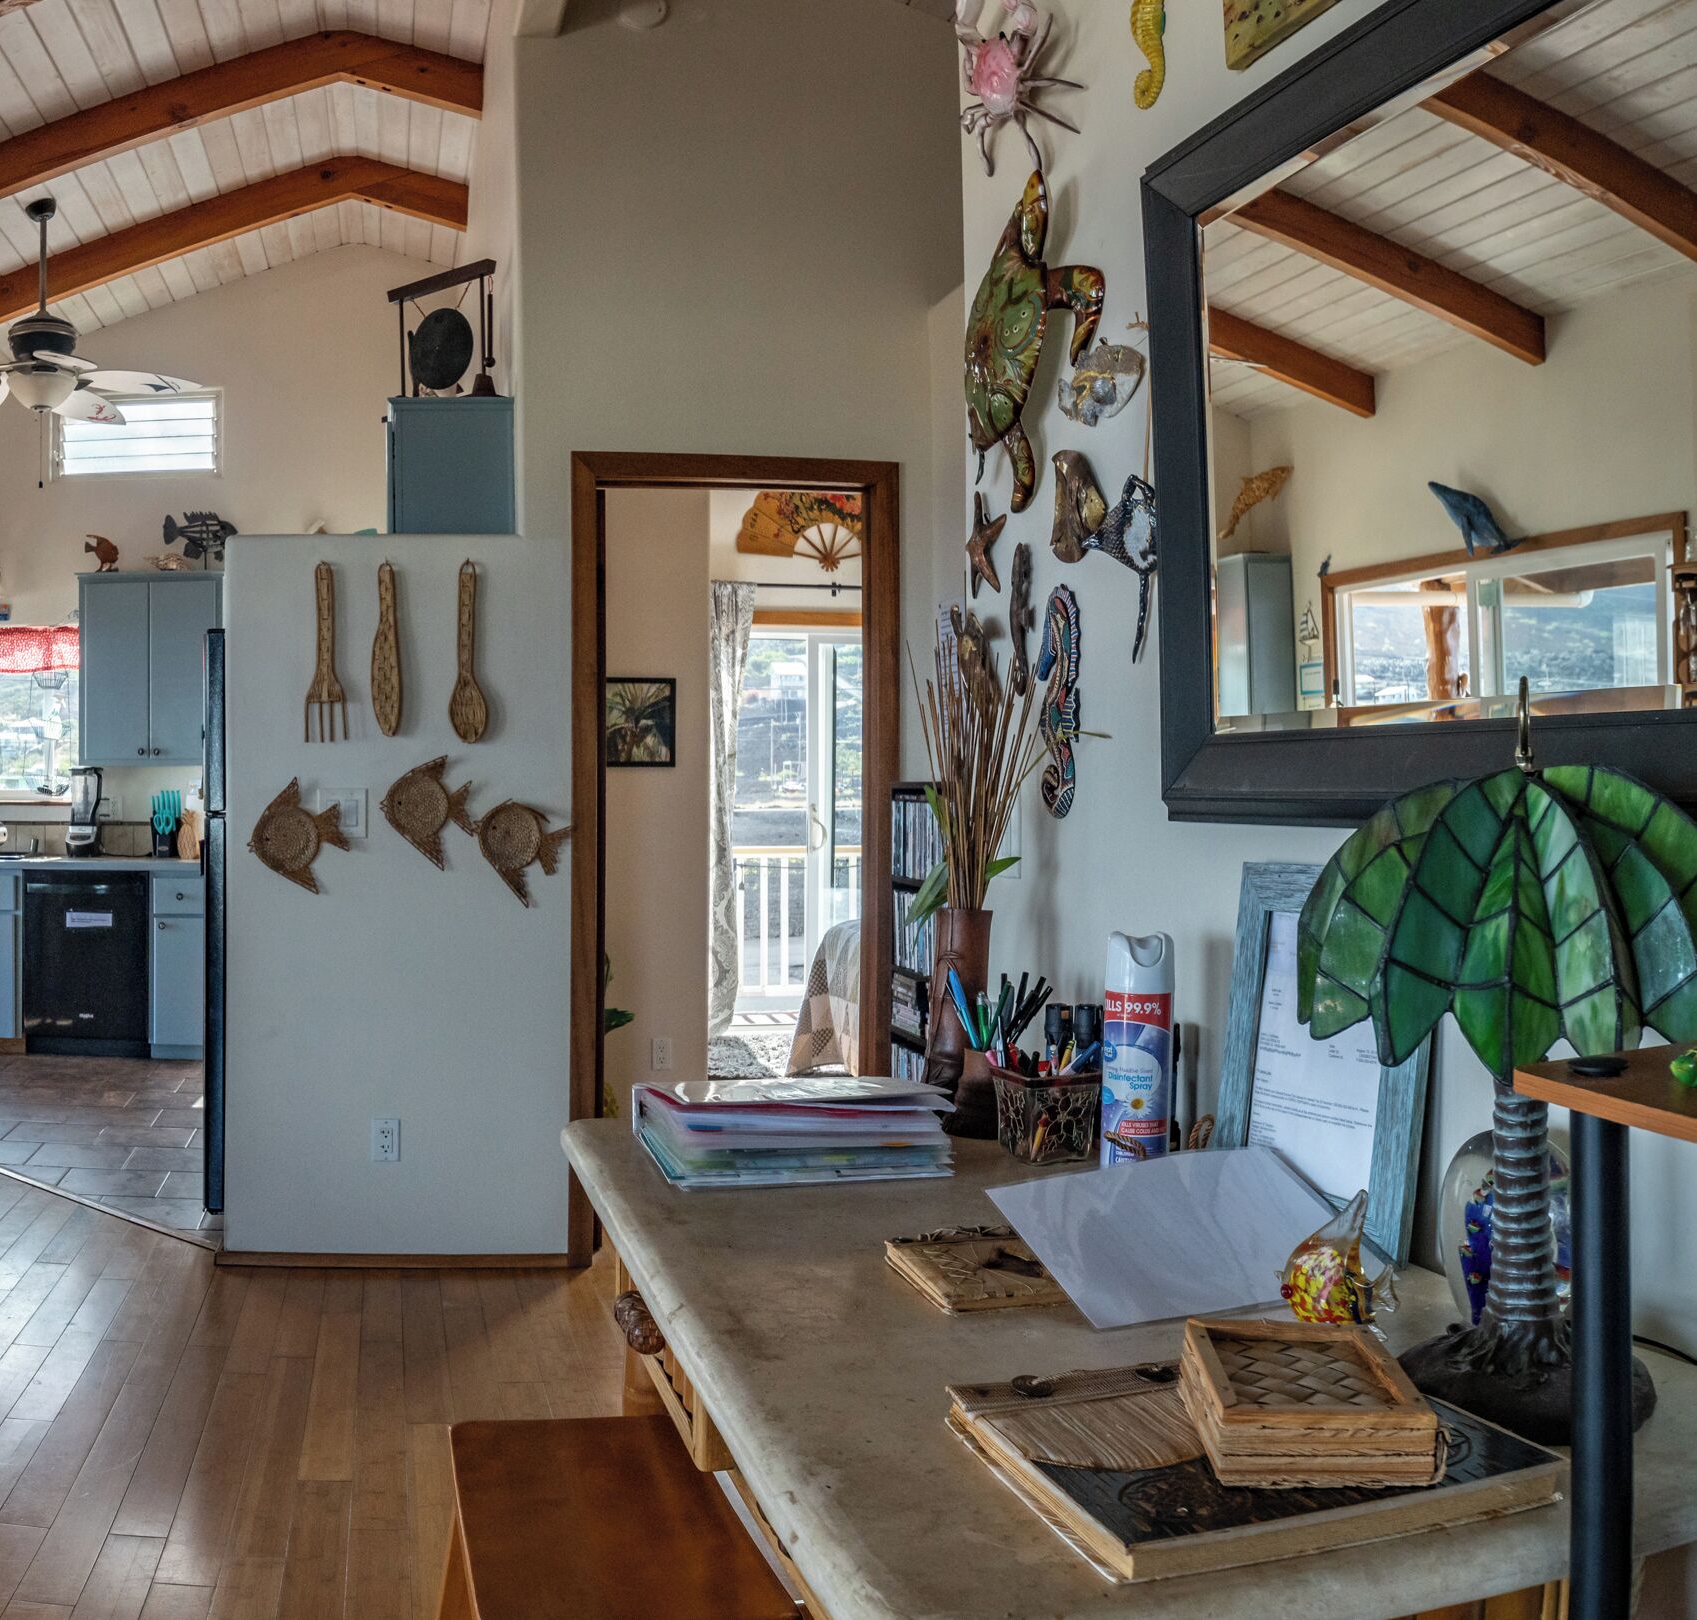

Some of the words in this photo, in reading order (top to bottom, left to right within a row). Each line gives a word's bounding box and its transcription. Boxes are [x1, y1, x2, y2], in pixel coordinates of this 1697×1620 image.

[1125, 1002, 1162, 1016] 99.9%
[1108, 1071, 1153, 1082] Disinfectant
[1129, 1082, 1153, 1091] Spray
